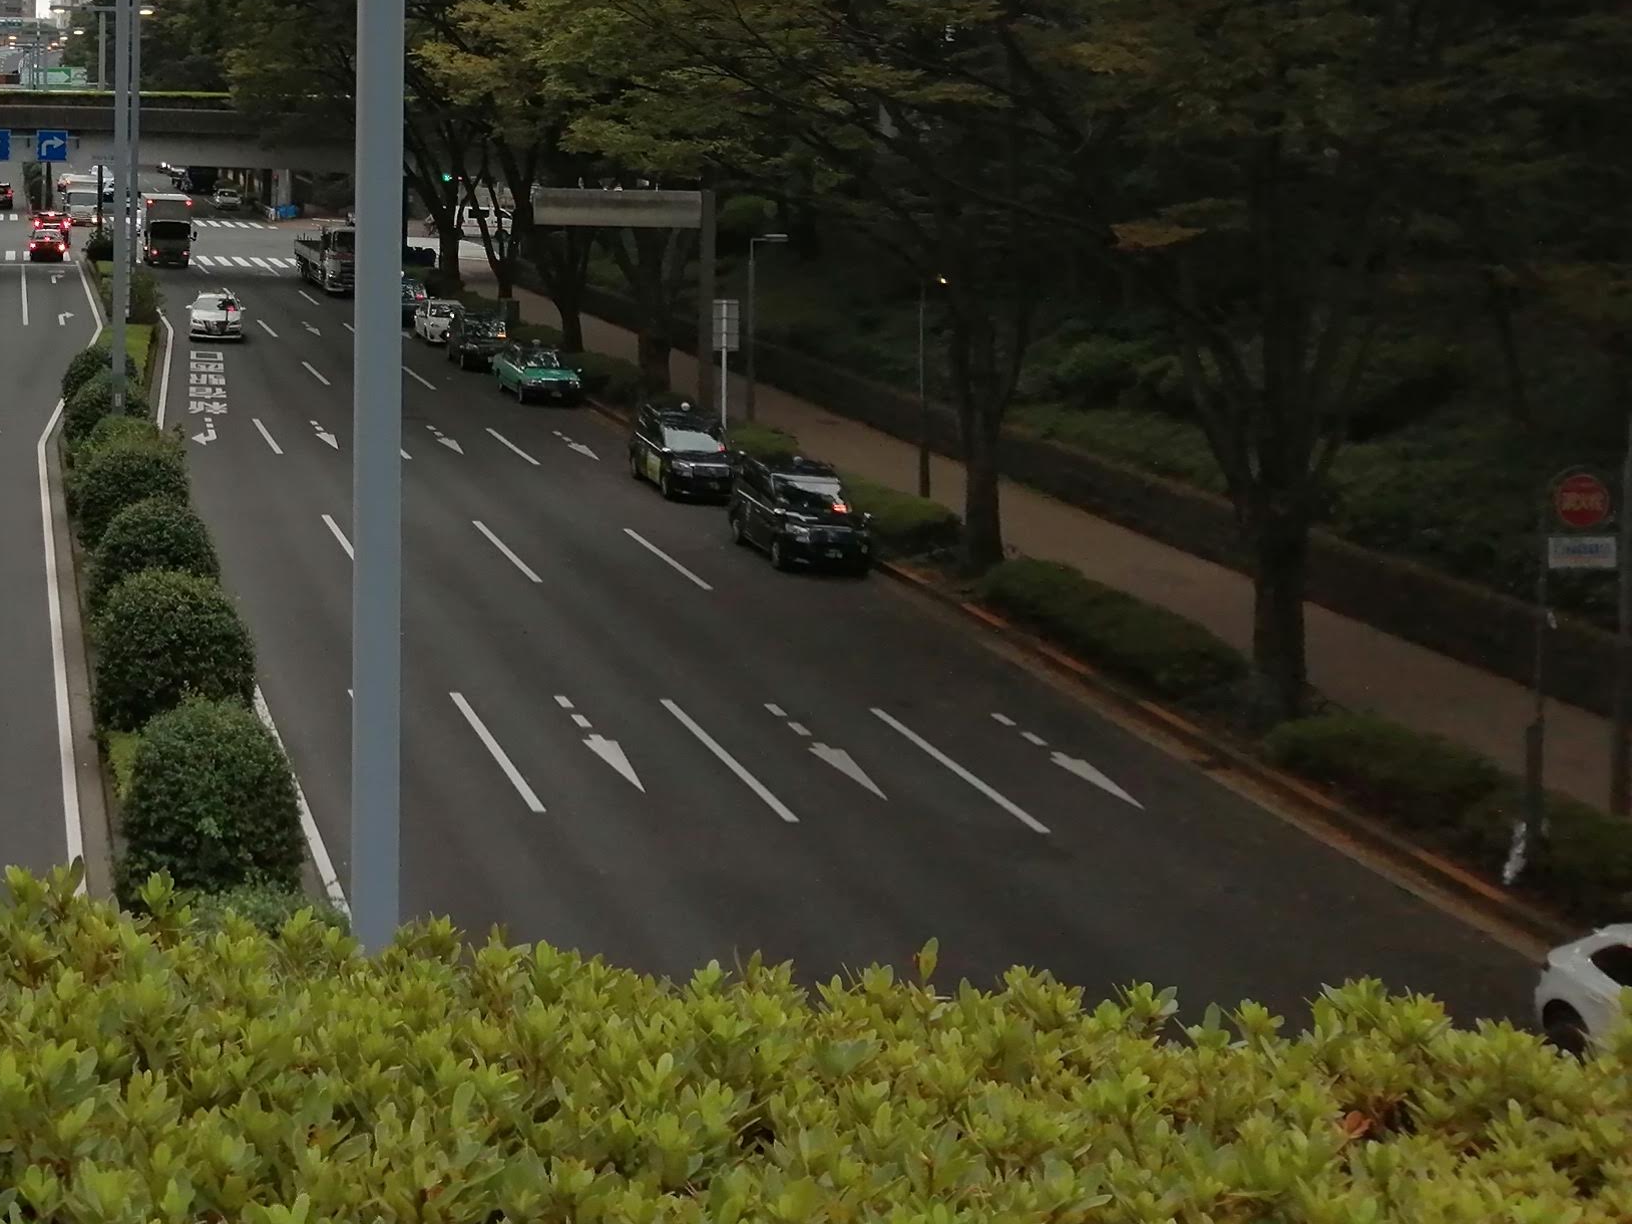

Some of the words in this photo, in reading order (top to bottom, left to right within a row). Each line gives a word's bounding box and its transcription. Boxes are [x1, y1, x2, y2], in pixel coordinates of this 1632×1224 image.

[189, 351, 227, 414] 新宿駅西口
